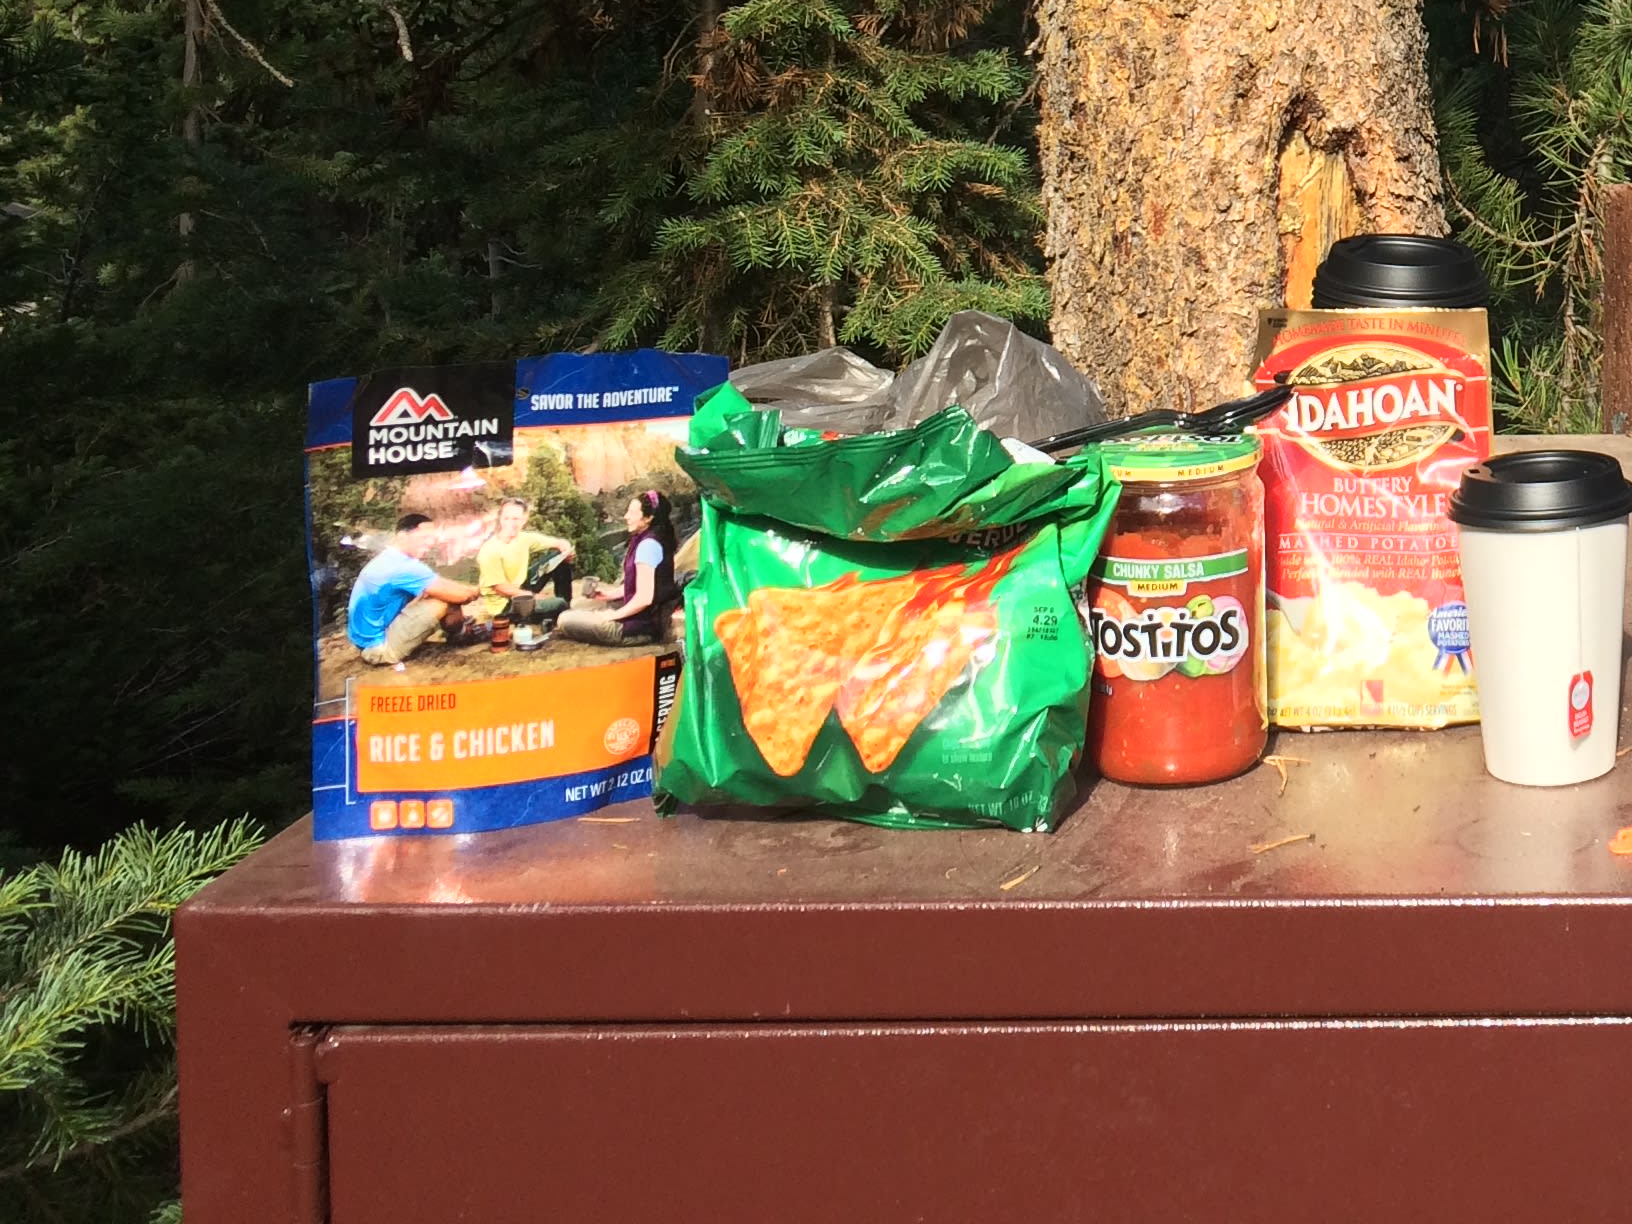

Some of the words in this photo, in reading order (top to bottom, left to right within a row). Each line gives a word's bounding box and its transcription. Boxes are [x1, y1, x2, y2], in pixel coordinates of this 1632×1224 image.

[1348, 317, 1385, 332] TASTE
[1389, 317, 1403, 331] IN
[530, 393, 574, 412] SAVOR
[576, 392, 600, 409] THE
[602, 387, 674, 408] ADVENTURE
[1285, 378, 1458, 433] IDAHOAN
[368, 418, 499, 446] MOUNTAIN
[368, 443, 455, 466] HOUSE
[1177, 464, 1225, 477] MEDIUM
[1333, 475, 1413, 494] BUTTERY
[1300, 492, 1447, 518] HOMESTYLE
[1279, 536, 1359, 549] MAHED
[1370, 535, 1459, 551] POTATOE
[1363, 554, 1394, 566] REAL
[1112, 562, 1160, 579] CHUNKY
[1163, 561, 1205, 577] SALSA
[1137, 582, 1179, 592] MEDIUM
[1032, 615, 1058, 626] 4.29
[1431, 618, 1466, 632] FAVORI
[370, 695, 413, 713] FREEZE
[417, 693, 457, 712] DRIED
[369, 733, 421, 764] RICE
[429, 731, 445, 762] &
[453, 719, 556, 759] CHICKEN
[565, 785, 588, 802] NET
[590, 780, 607, 798] WT
